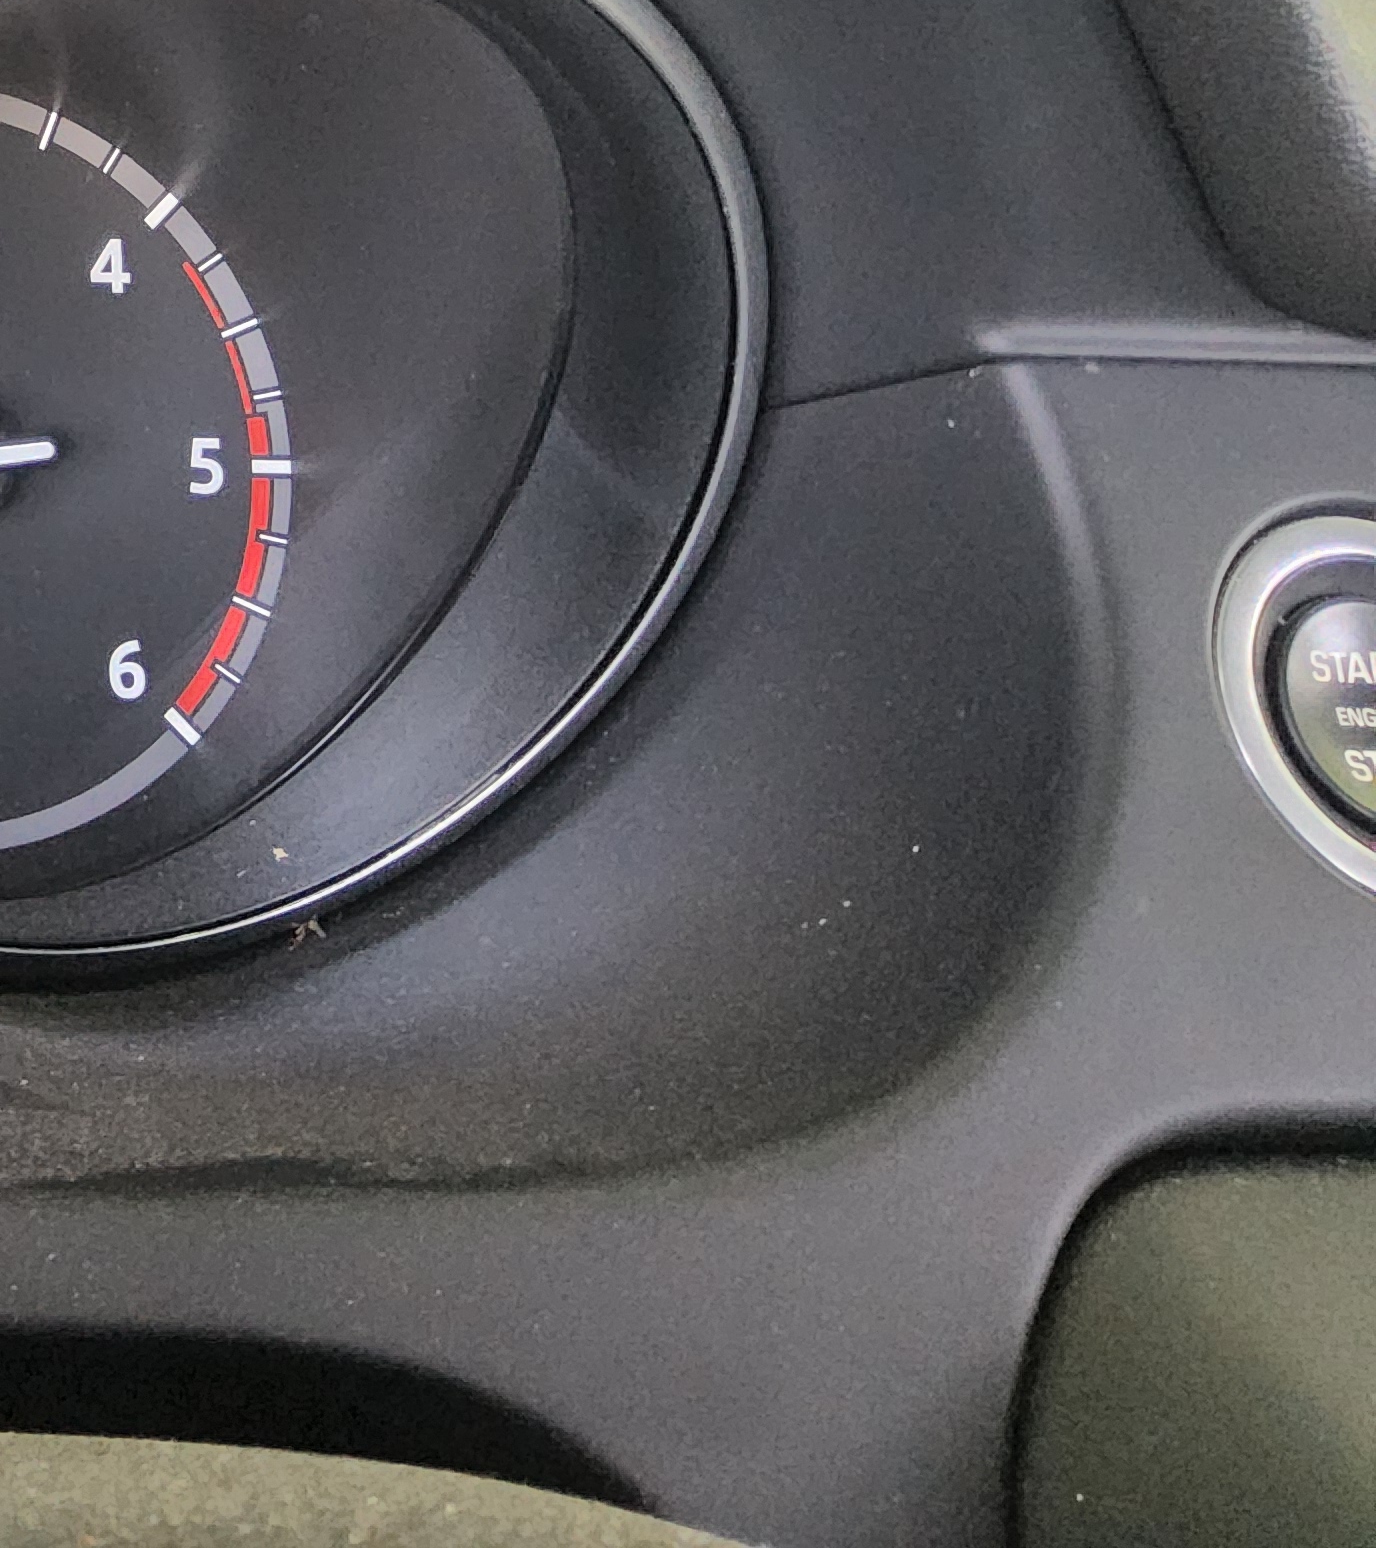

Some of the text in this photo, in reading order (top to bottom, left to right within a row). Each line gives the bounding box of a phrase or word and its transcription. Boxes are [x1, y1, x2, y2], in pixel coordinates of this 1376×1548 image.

[89, 238, 131, 294] 4
[189, 437, 224, 495] 5
[108, 639, 146, 700] 6
